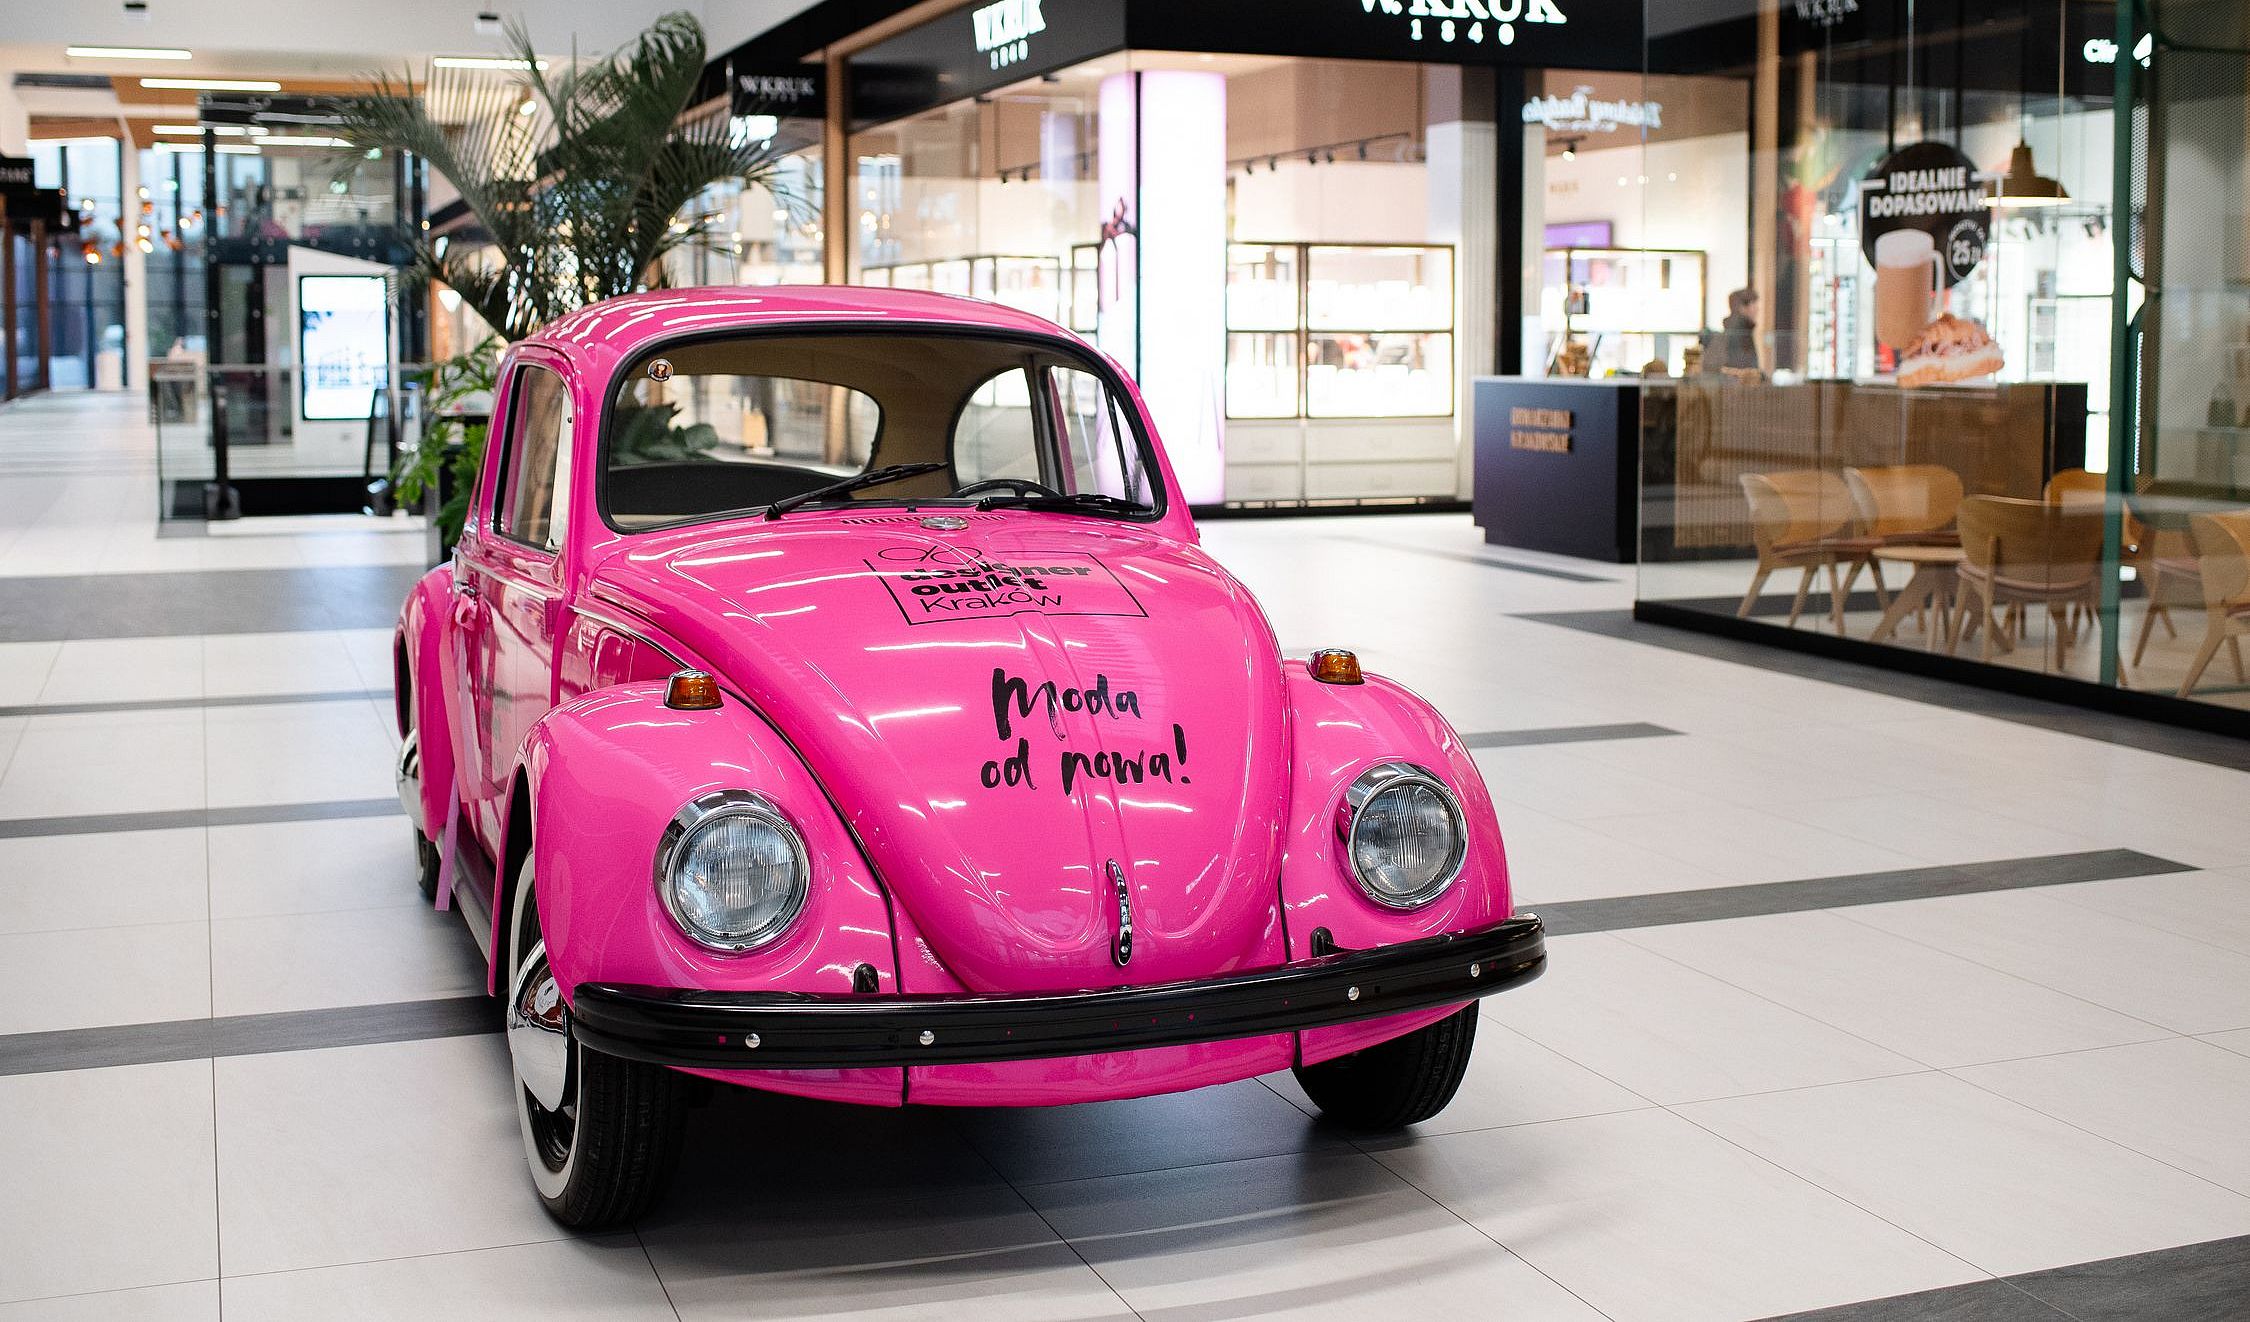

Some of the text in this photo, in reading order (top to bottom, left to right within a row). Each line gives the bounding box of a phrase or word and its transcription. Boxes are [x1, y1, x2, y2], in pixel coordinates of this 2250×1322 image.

[1410, 18, 1515, 46] 1840
[1889, 166, 1967, 194] IDEALNIE
[900, 560, 1093, 582] designer
[910, 571, 1048, 596] outlet
[919, 587, 1062, 613] Kraków
[991, 667, 1142, 742] Moda
[980, 723, 1192, 797] od nowa!
